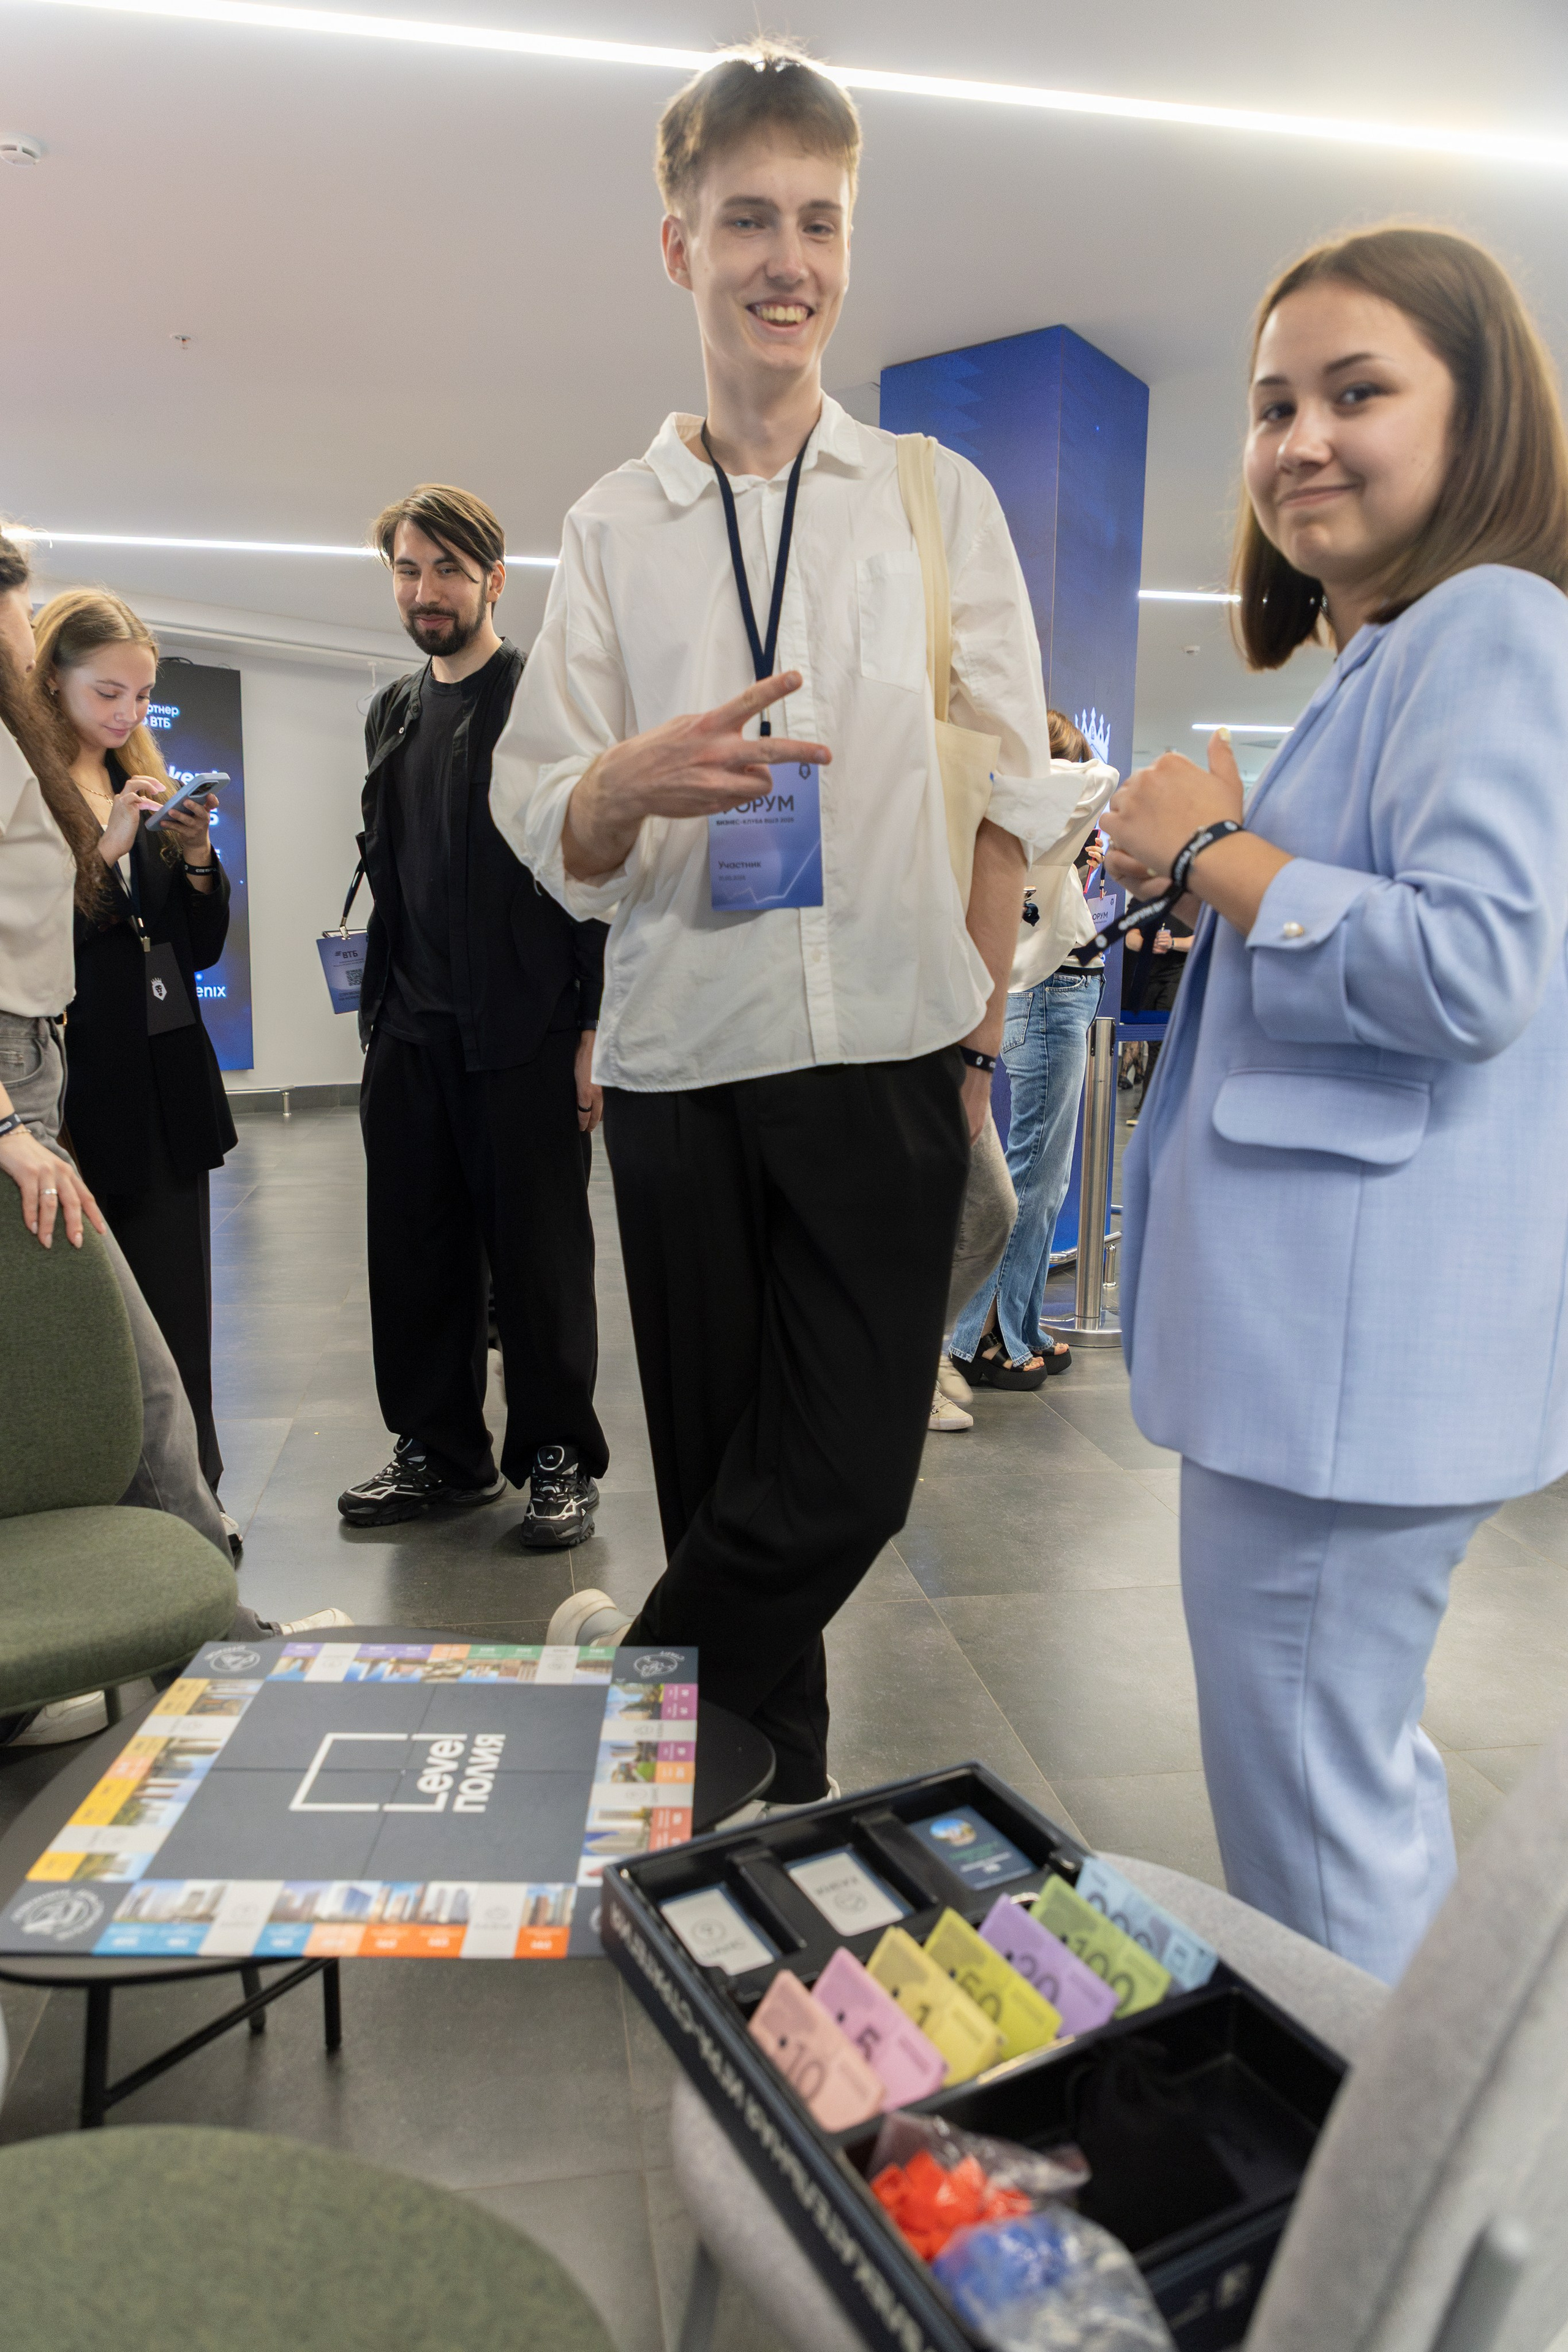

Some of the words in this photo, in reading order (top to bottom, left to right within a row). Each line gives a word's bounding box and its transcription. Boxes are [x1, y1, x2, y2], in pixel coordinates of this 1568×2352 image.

[147, 704, 179, 717] ртнер
[150, 716, 171, 728] ВТБ
[722, 794, 794, 814] ОРУМ
[718, 861, 761, 869] Участник
[1093, 911, 1108, 920] ОРУМ
[197, 986, 226, 998] enix
[383, 1733, 468, 1812] Level
[855, 2026, 881, 2062] 5
